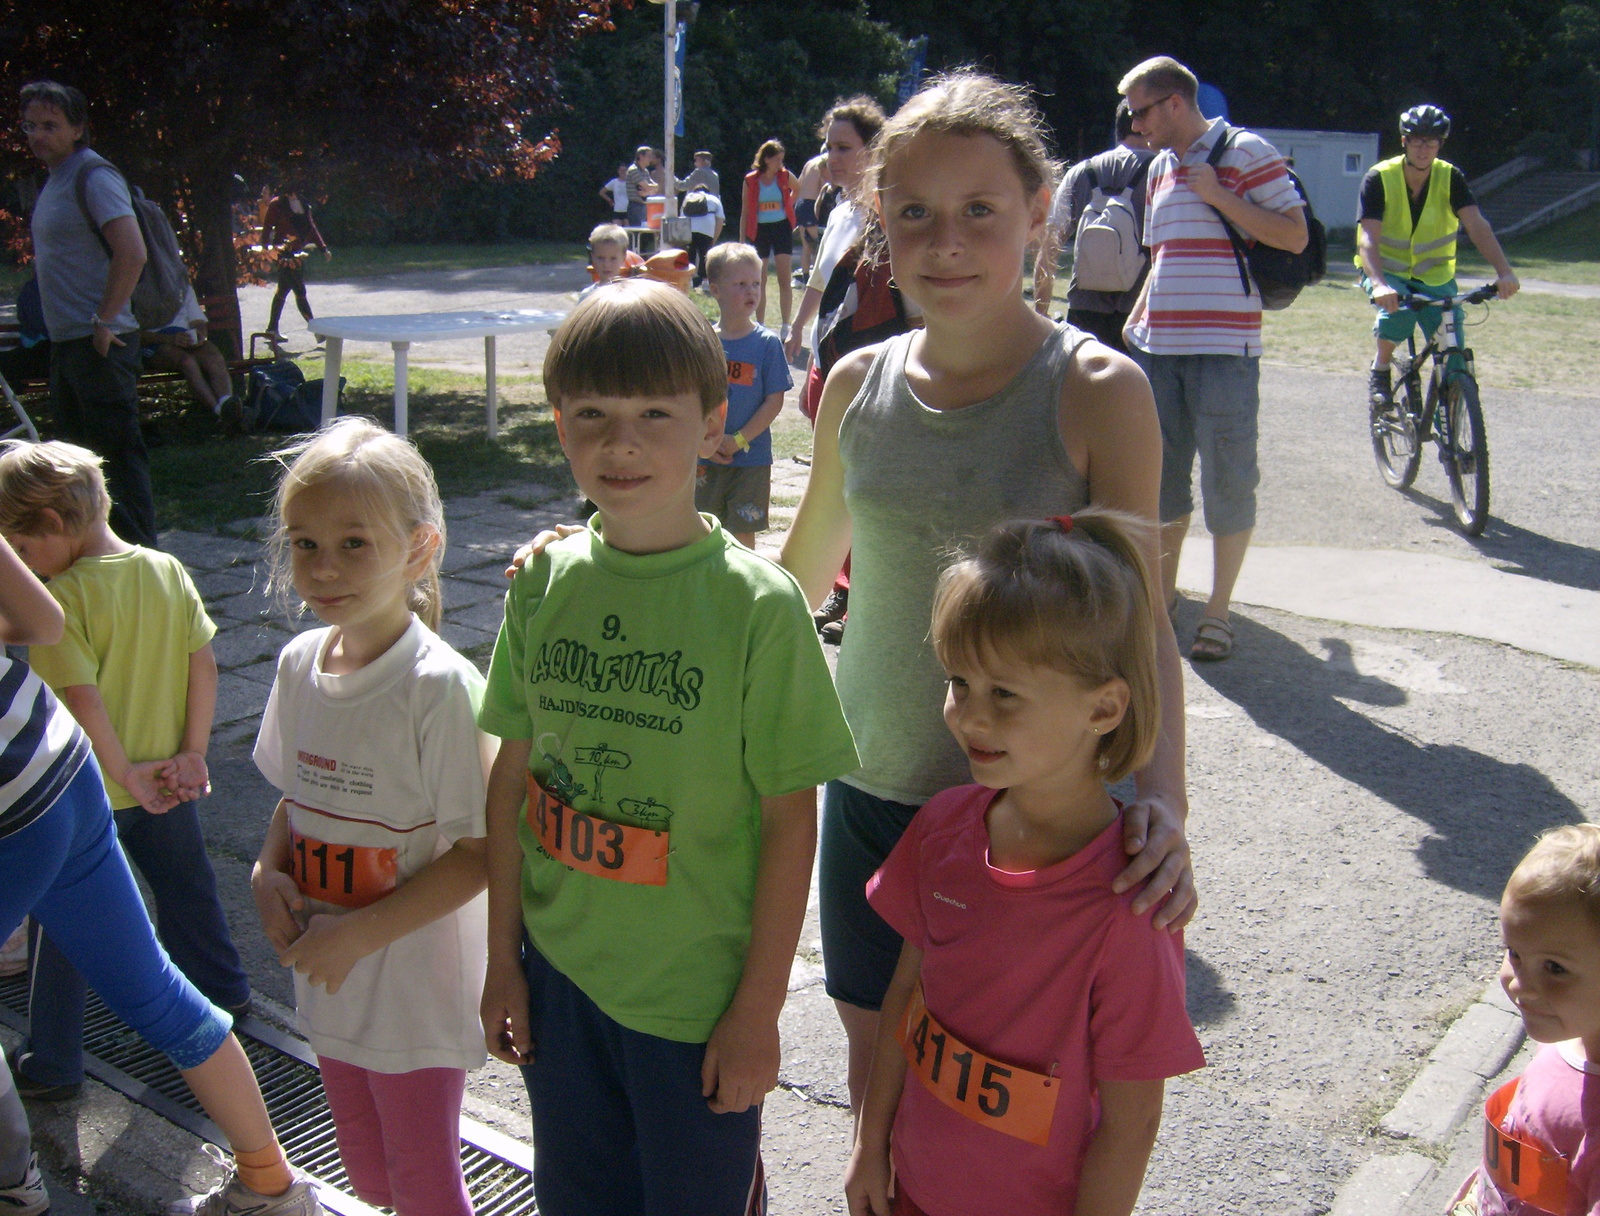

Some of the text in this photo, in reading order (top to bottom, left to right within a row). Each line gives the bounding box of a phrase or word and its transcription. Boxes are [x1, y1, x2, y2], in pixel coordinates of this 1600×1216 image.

[601, 614, 627, 642] 9.
[530, 638, 704, 711] AQUAFUTÁS
[536, 791, 625, 870] 4103
[933, 891, 967, 910] Quechua
[912, 1013, 1012, 1118] 4115
